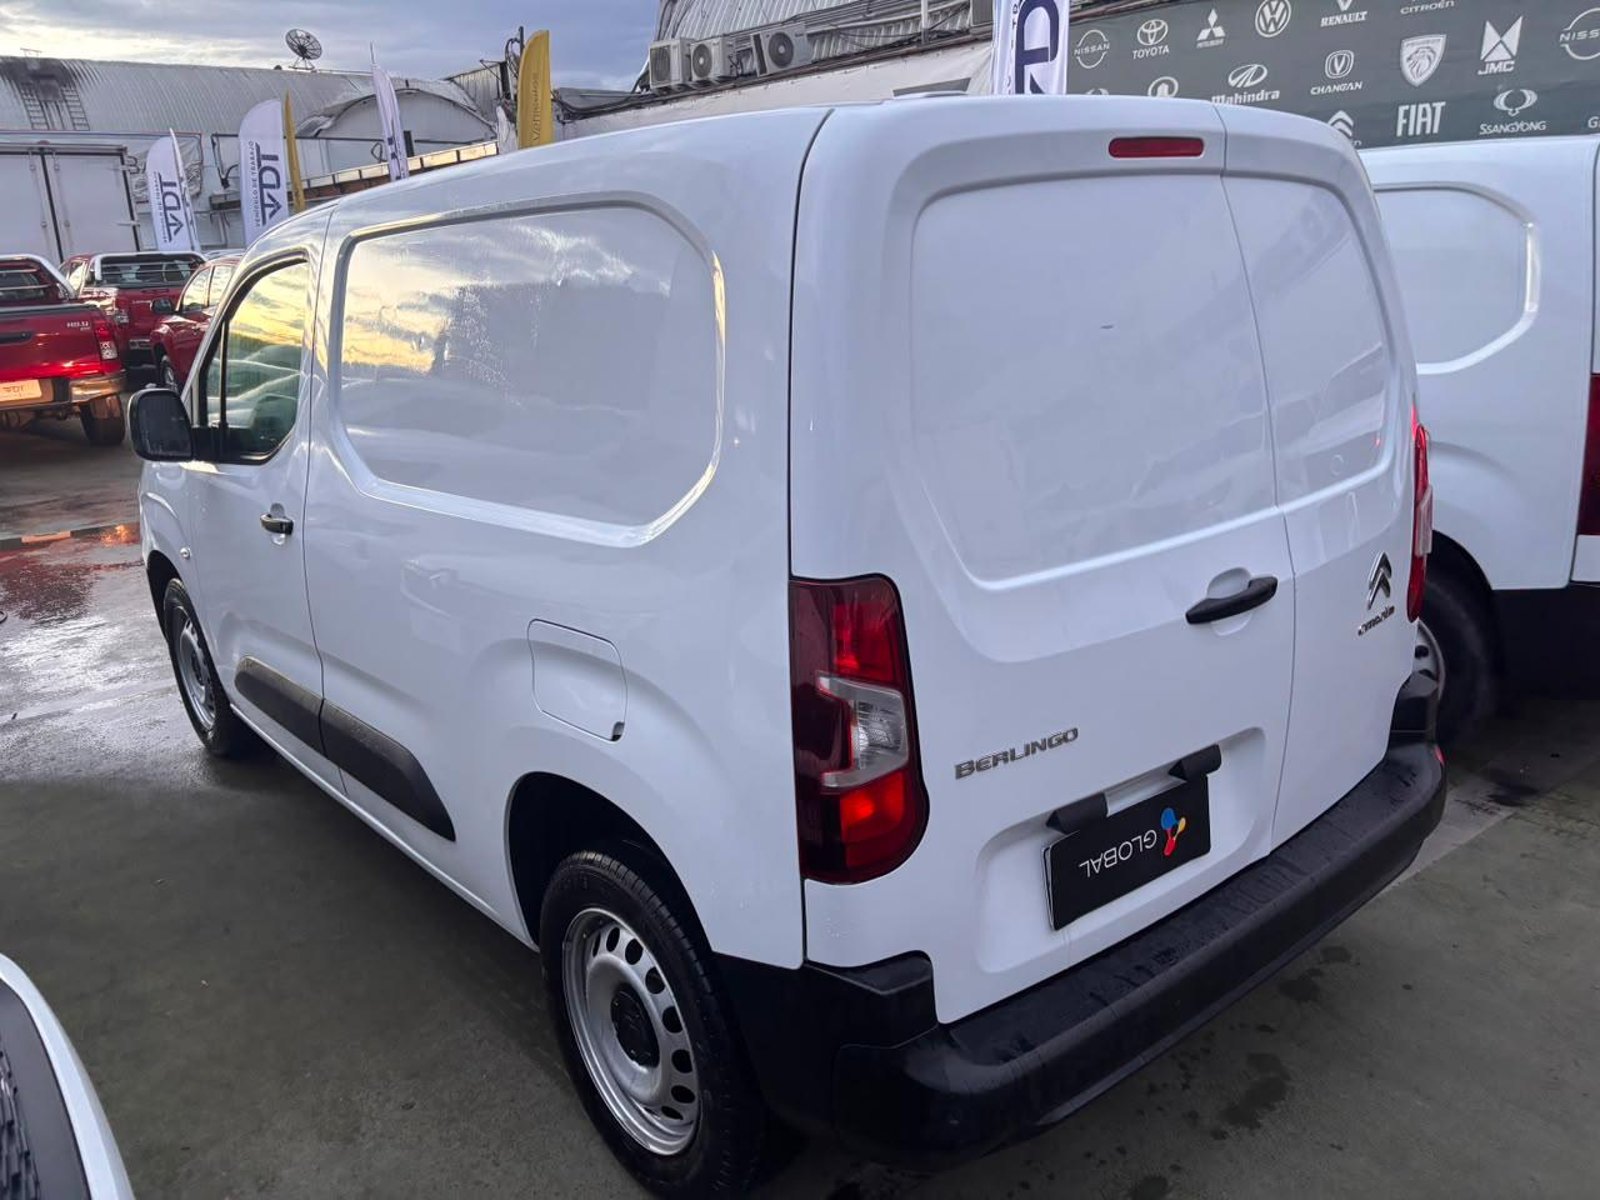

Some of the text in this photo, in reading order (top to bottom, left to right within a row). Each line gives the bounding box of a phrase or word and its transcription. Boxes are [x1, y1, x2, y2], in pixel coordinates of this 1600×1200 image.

[1320, 11, 1368, 27] RENAULT
[1559, 29, 1600, 41] NISS
[1074, 42, 1110, 55] NISSAN
[1132, 45, 1169, 60] TOYOTA
[1477, 60, 1515, 75] JMC
[1310, 81, 1363, 96] CHANGAN
[1211, 89, 1280, 105] Mahindra
[1396, 101, 1446, 137] FIAT
[955, 727, 1079, 780] BERLINGO
[1079, 829, 1157, 878] GLOBAL
